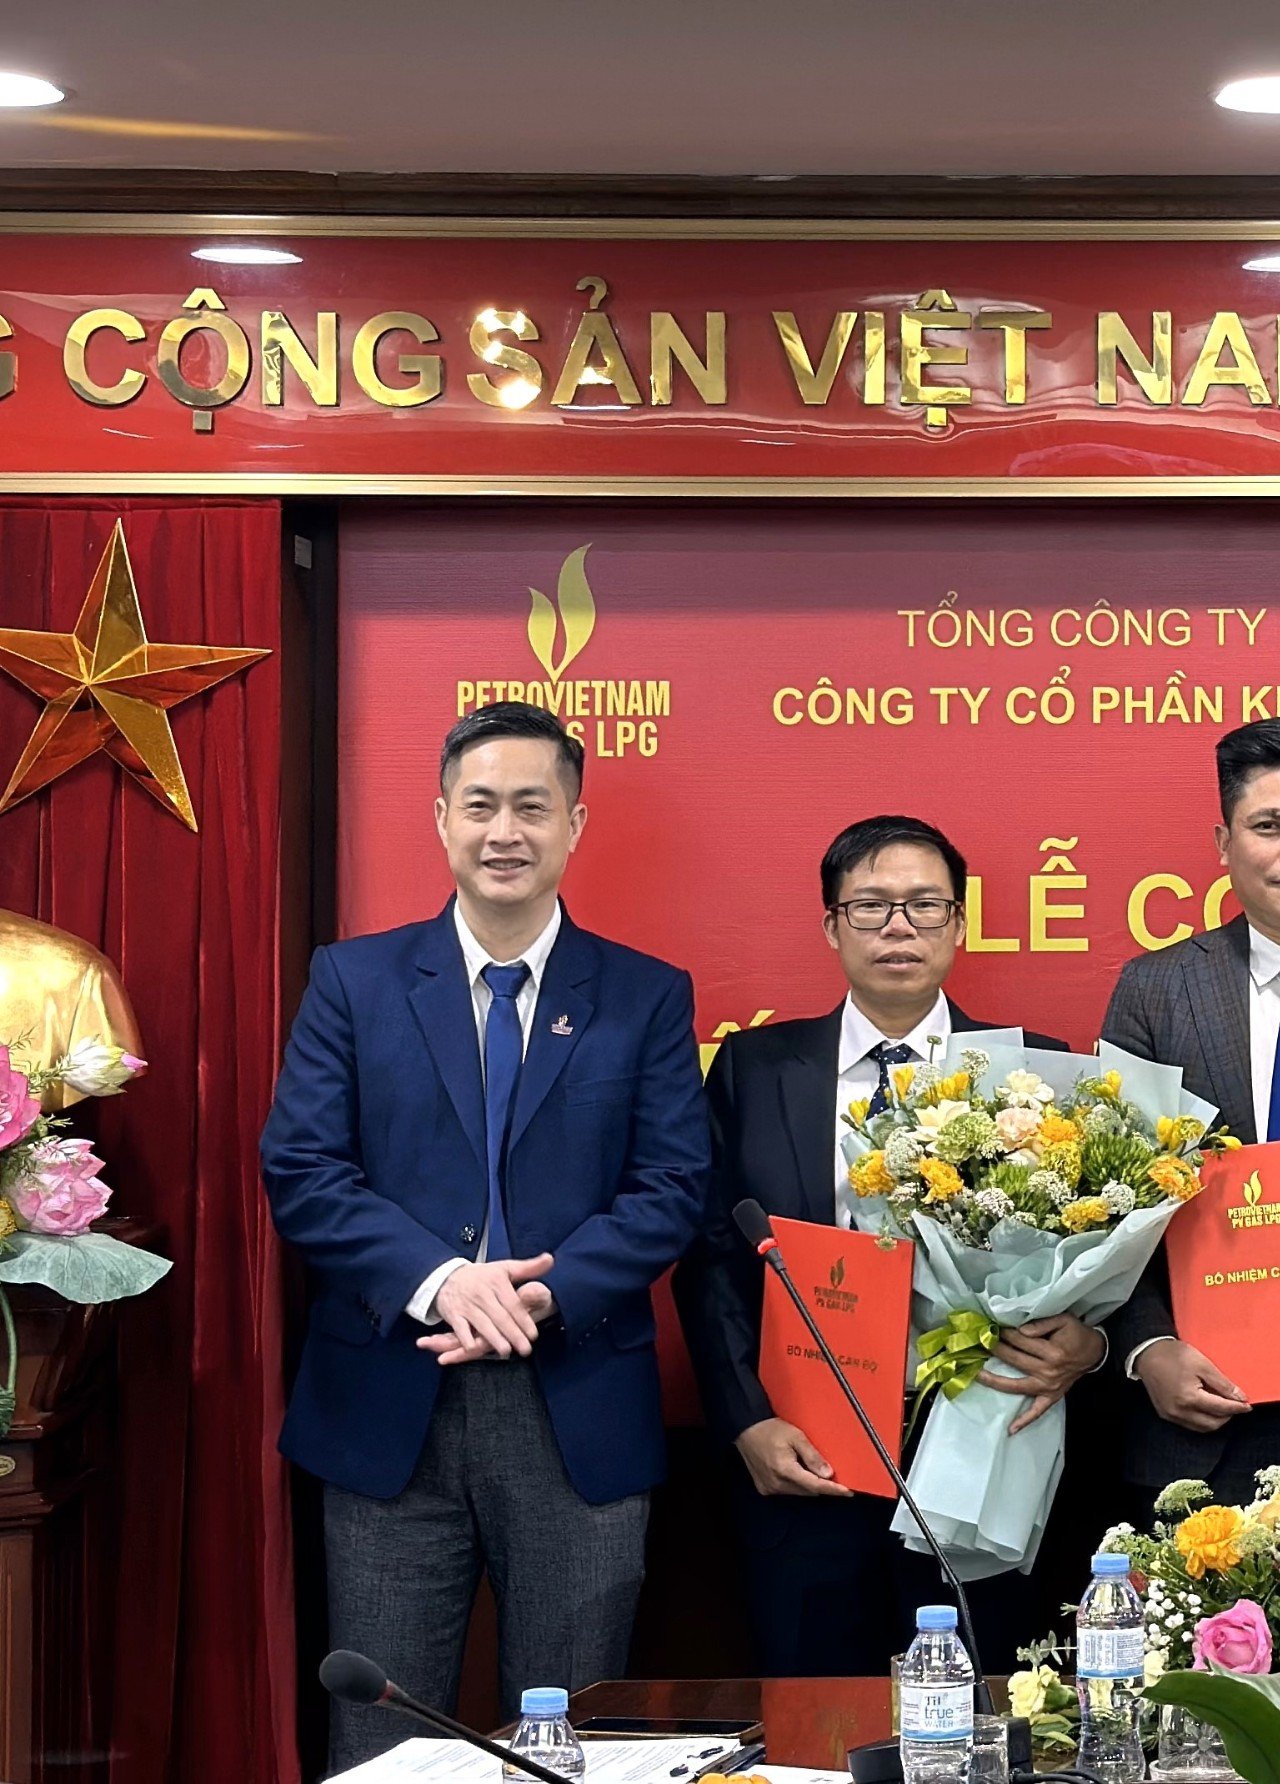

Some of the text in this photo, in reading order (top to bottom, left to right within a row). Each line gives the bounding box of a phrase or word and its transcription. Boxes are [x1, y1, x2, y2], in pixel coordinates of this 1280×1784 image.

[62, 287, 443, 431] CỘNG
[466, 276, 727, 408] SẢN
[772, 289, 1053, 427] VIỆT
[897, 590, 1033, 648] TỔNG
[1050, 598, 1192, 647] CÔNG
[1207, 610, 1267, 646] TY
[457, 680, 670, 717] PETROVIETNAM
[772, 677, 914, 726] CÔNG
[930, 687, 989, 725] TY
[1004, 665, 1076, 725] CỔ
[1092, 670, 1224, 724] PHẦN
[597, 720, 658, 757] LPG
[965, 837, 1089, 952] LỄ
[924, 1705, 954, 1719] true
